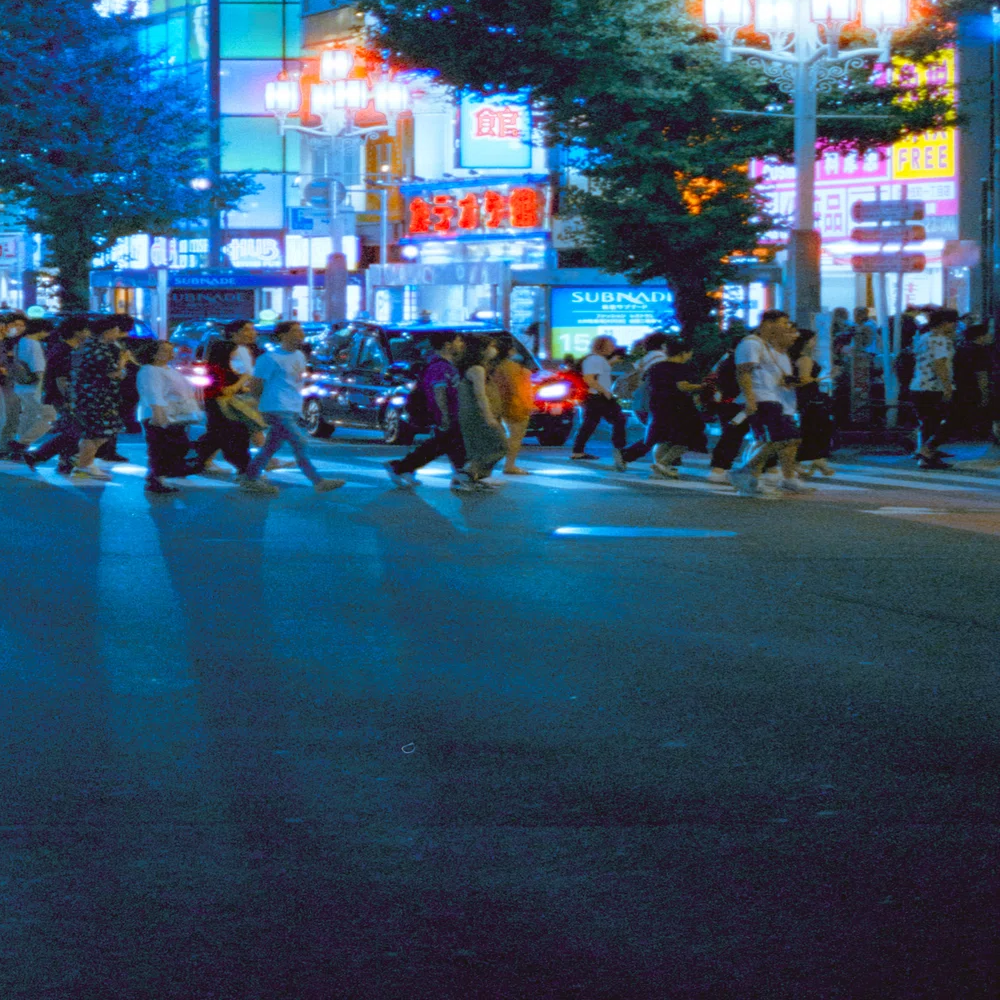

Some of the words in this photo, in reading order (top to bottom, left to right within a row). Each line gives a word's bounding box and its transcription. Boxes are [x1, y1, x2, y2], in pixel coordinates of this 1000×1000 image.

[899, 147, 949, 172] FREE
[174, 277, 236, 285] SUBNADE
[560, 333, 592, 352] 15
